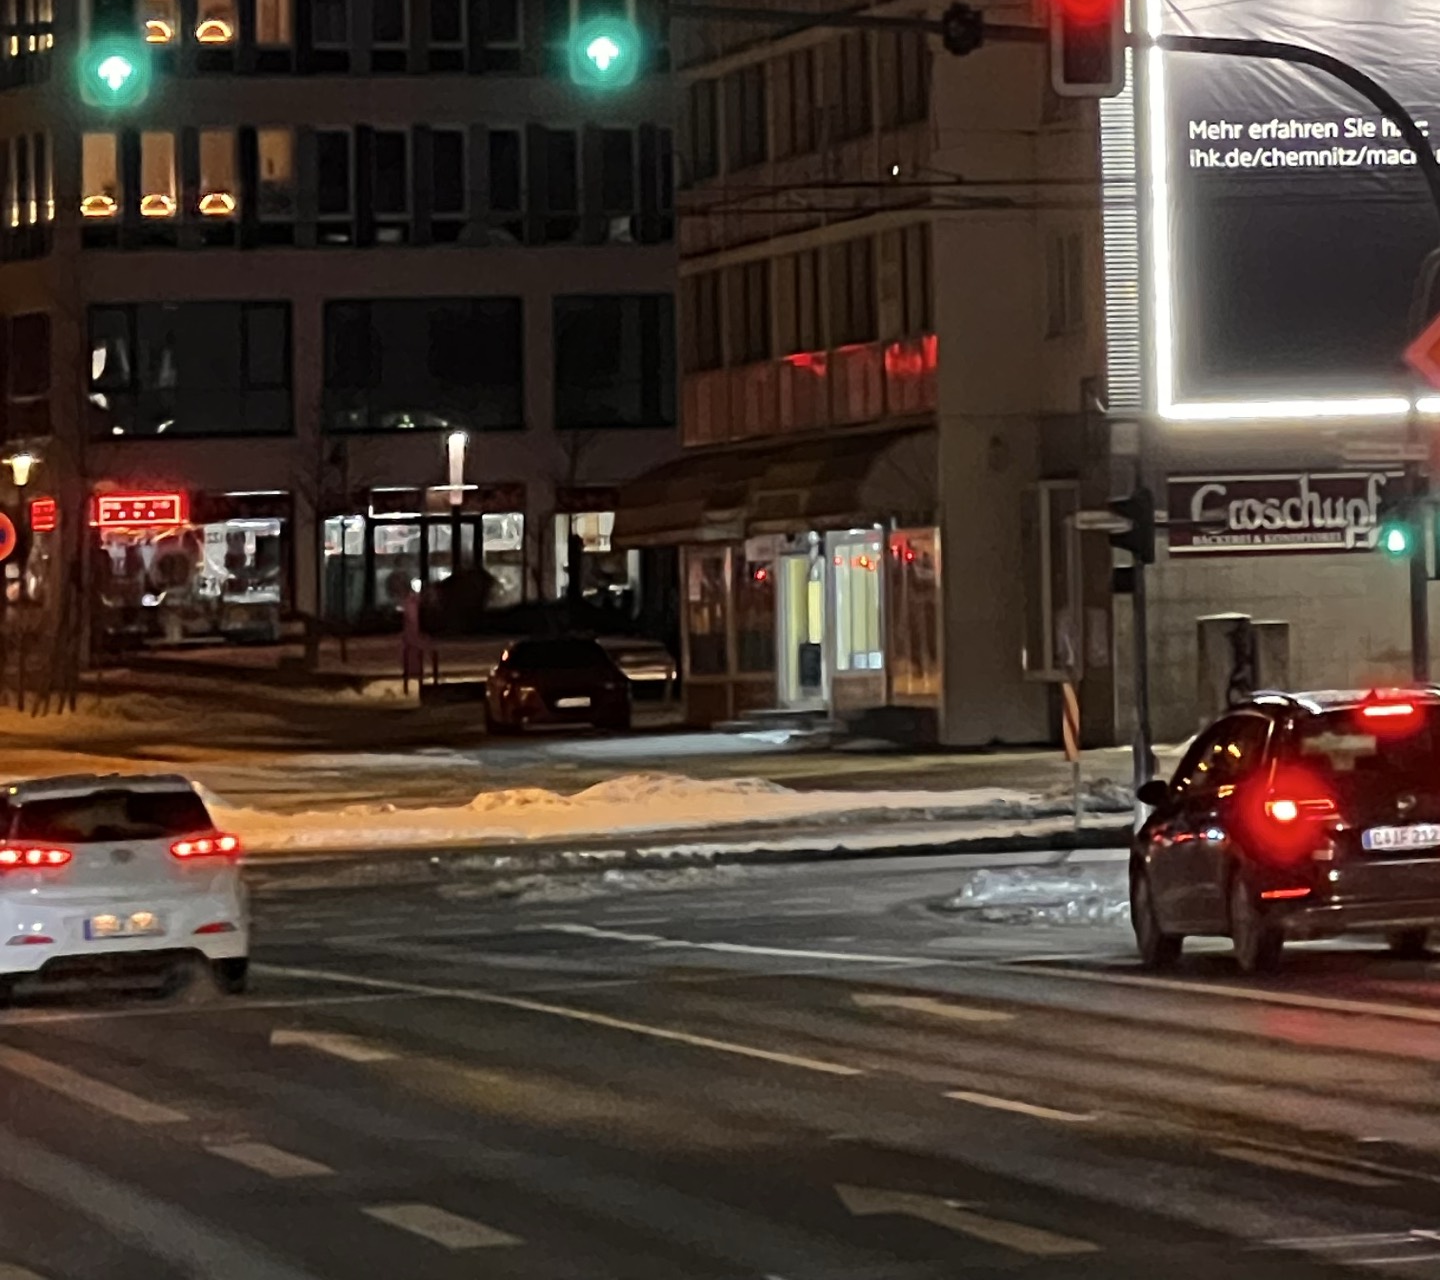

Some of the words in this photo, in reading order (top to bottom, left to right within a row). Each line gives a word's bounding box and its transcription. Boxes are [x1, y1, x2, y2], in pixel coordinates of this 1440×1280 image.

[1189, 120, 1243, 140] Mehr
[1248, 119, 1339, 139] erfahren
[1344, 118, 1376, 138] Sie
